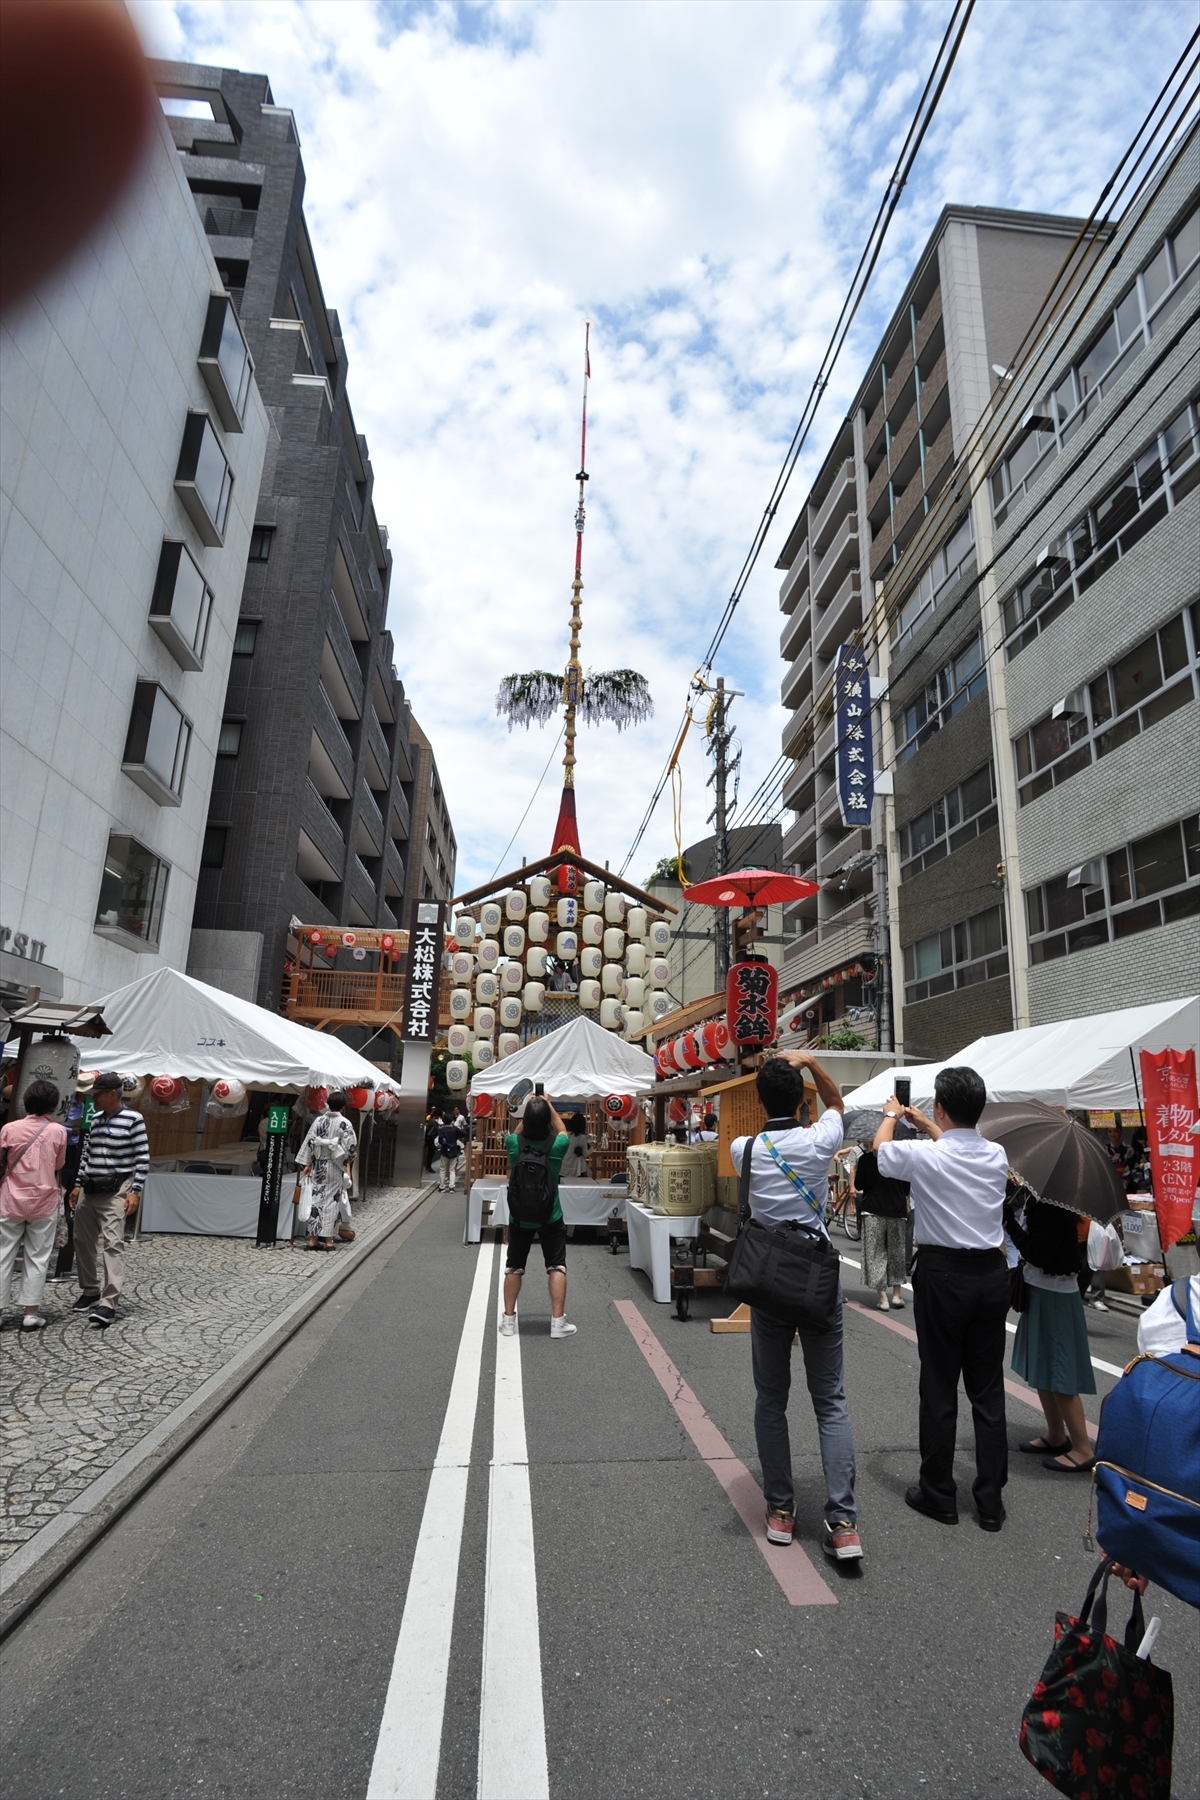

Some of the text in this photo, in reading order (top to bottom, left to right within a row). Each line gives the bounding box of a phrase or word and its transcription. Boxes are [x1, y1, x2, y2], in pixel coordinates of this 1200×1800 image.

[566, 900, 575, 924] 菊水鉾
[407, 928, 437, 1037] 大松株式会社
[735, 967, 772, 1042] 菊水鉾
[270, 1111, 279, 1128] 入口
[281, 1112, 288, 1129] 入口
[1156, 1103, 1194, 1128] 着物
[1156, 1128, 1195, 1143] レタル
